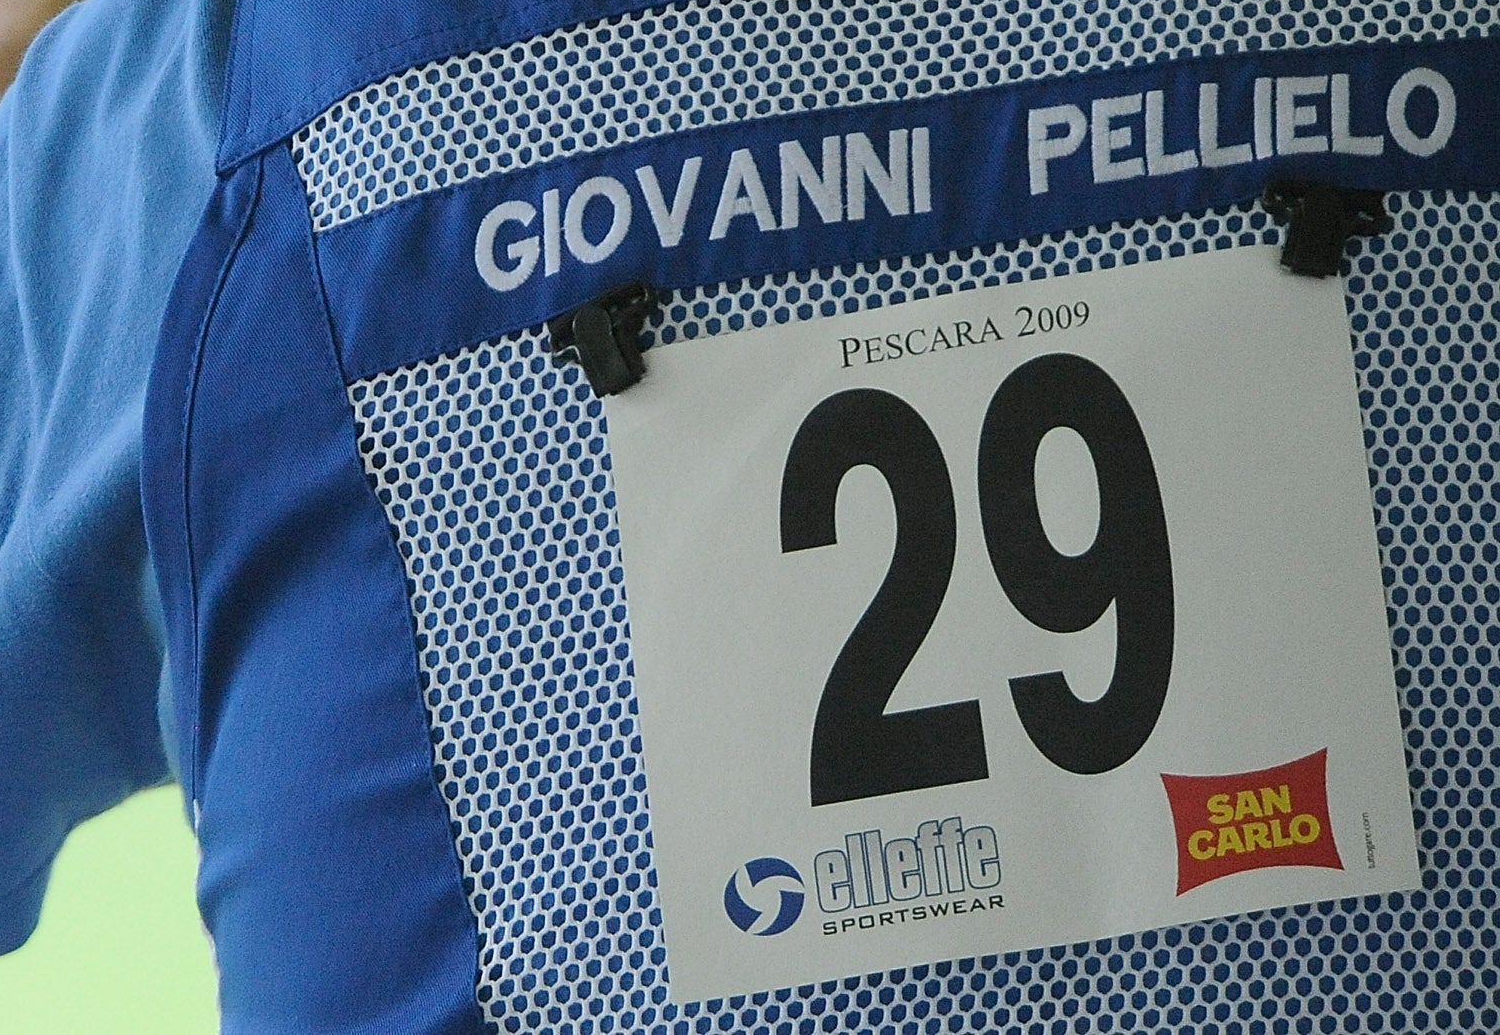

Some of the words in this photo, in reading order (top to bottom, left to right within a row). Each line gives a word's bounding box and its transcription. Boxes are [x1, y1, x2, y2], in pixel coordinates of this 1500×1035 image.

[474, 126, 932, 293] GIOVANNI
[1026, 67, 1457, 196] PELLIELO
[1015, 301, 1091, 337] 2009
[780, 352, 1176, 807] 29
[1206, 784, 1293, 824] SAN
[1187, 814, 1321, 860] CARLO
[813, 816, 1002, 914] elleffe
[822, 894, 1005, 936] SPORTSWEAR
